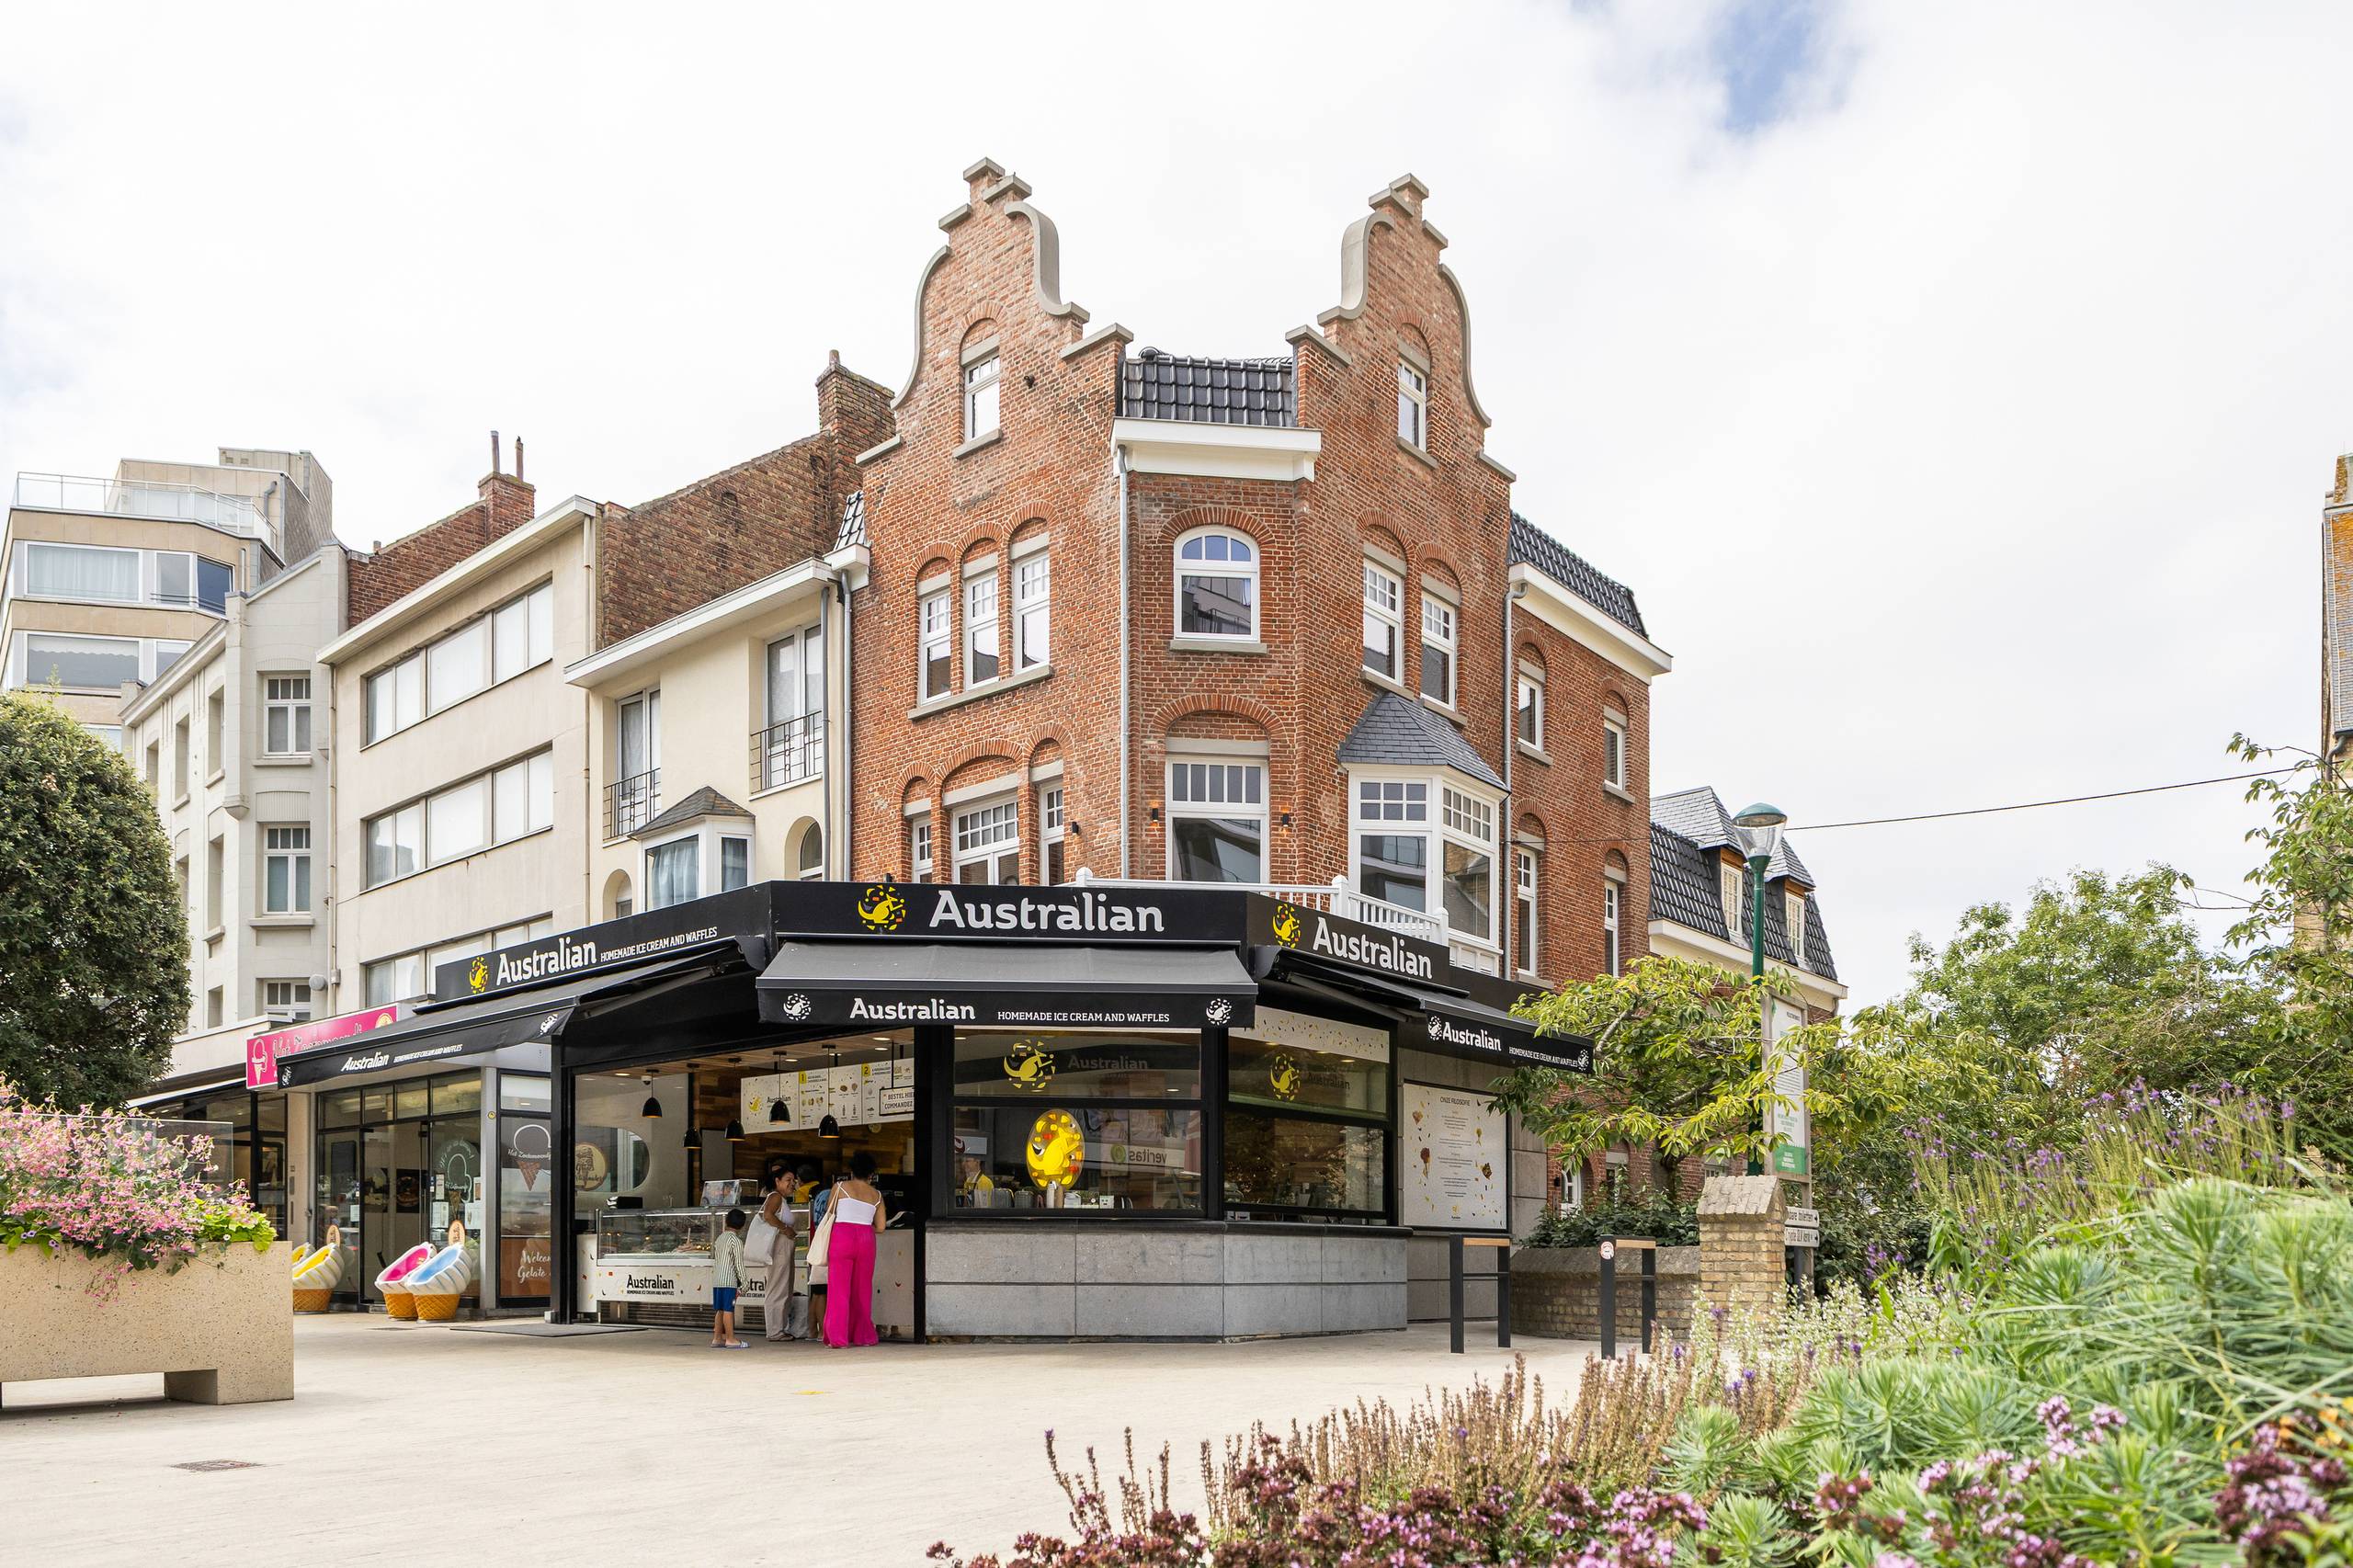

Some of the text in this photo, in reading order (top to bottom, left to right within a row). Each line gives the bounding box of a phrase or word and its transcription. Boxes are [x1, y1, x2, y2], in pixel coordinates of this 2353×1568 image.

[929, 890, 1165, 932] Australian
[496, 926, 718, 986] Australian HOMEMADE ICE CREAM AND WAFFLES
[1313, 916, 1432, 979] Australian
[849, 997, 1169, 1022] Australian HOMEMADE ICE CREAM AND WAFFLES
[1442, 1021, 1502, 1051] Australian
[1508, 1046, 1533, 1058] HOMEMADE
[341, 1051, 390, 1072] Australian
[864, 1066, 869, 1074] 2
[1067, 1054, 1148, 1070] Australian
[884, 1100, 913, 1109] COMMANDEZ
[626, 1274, 675, 1290] Australian
